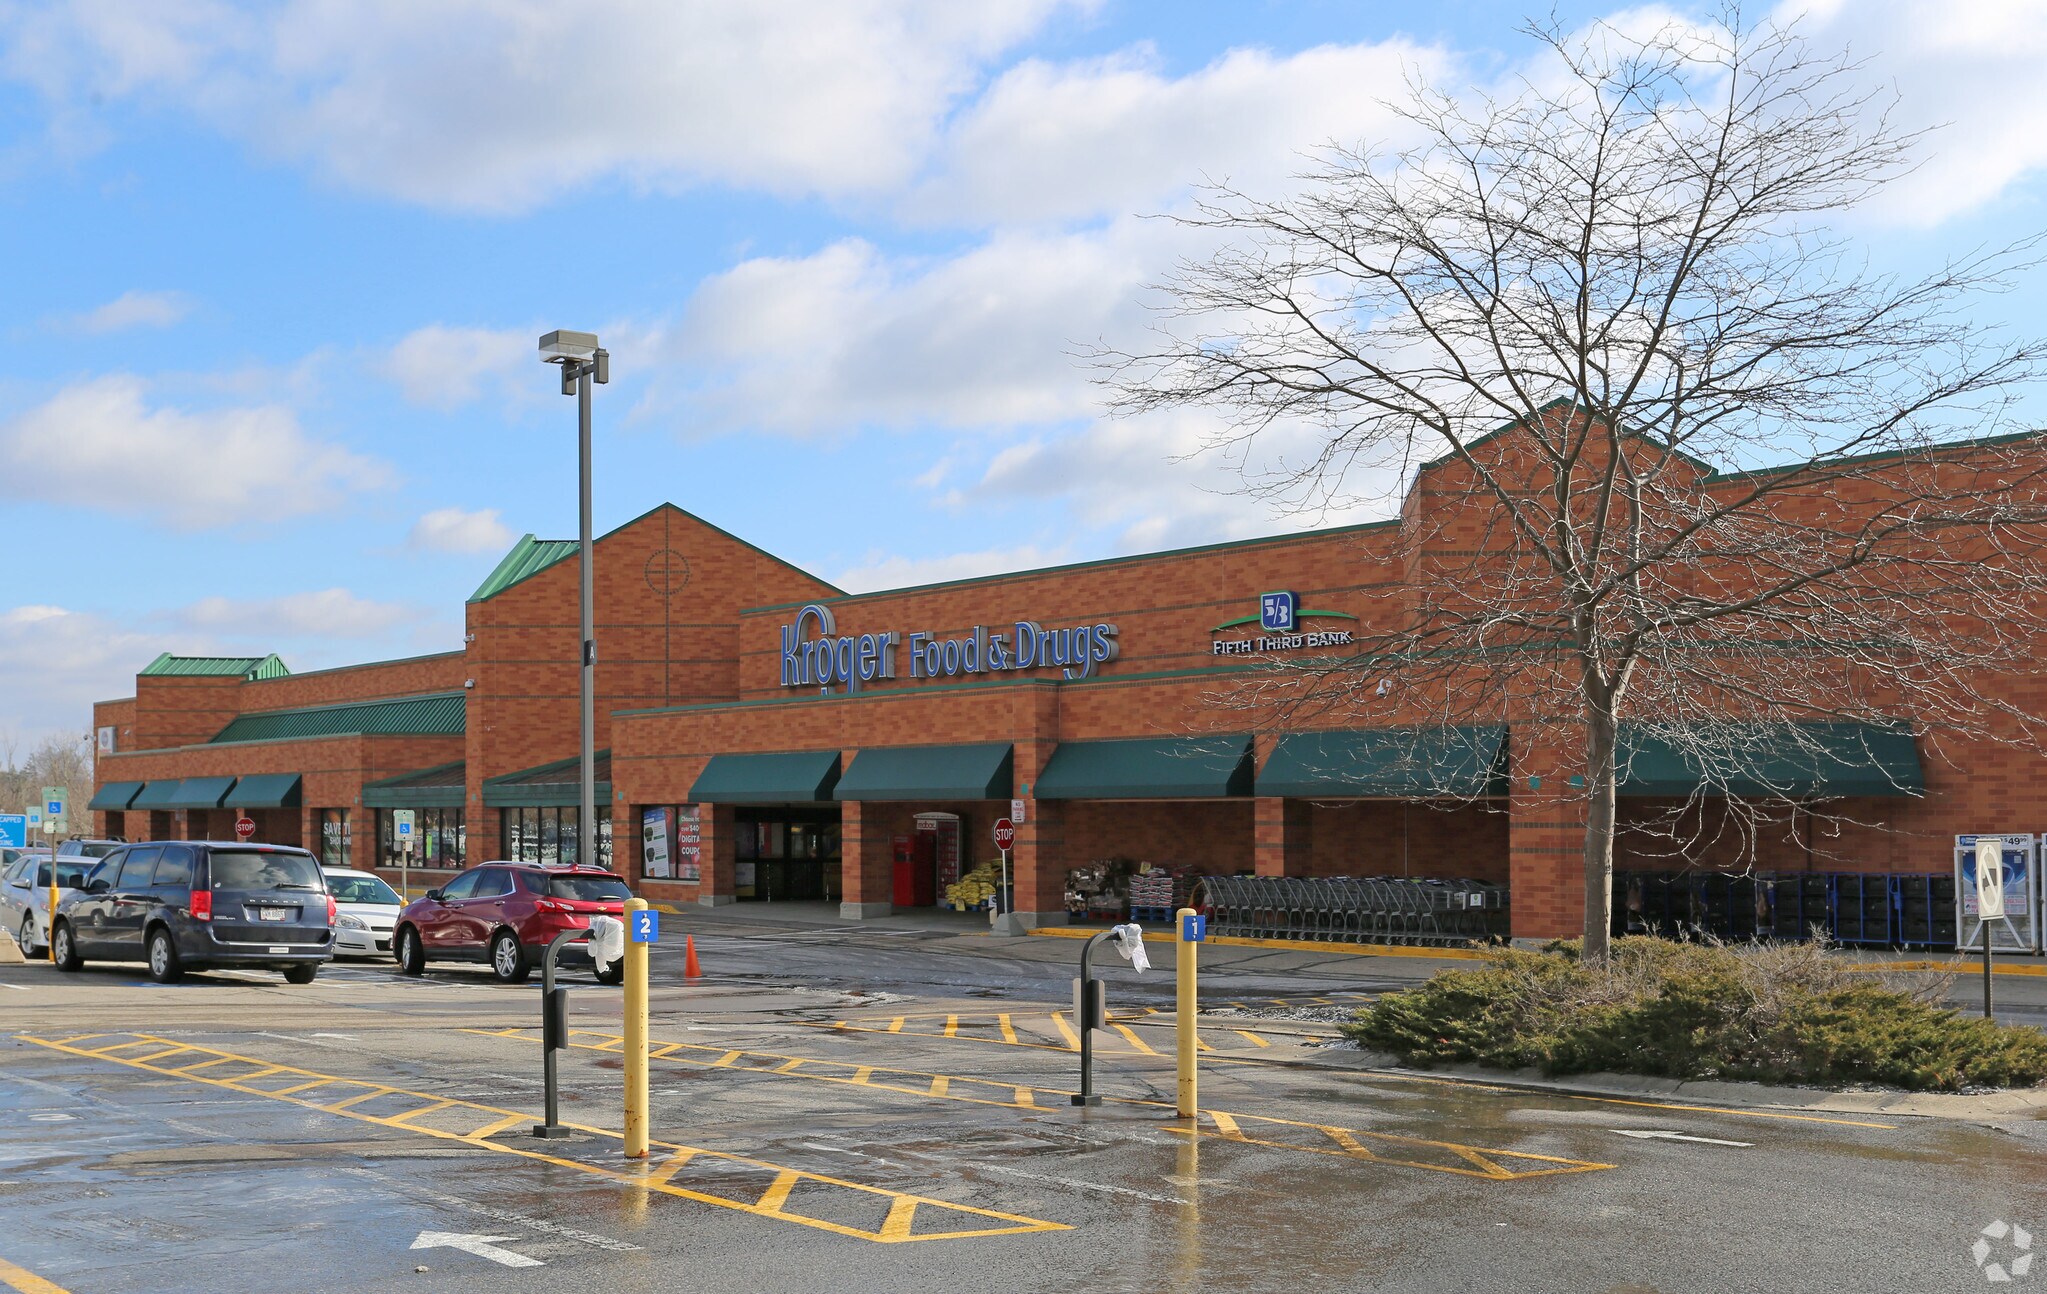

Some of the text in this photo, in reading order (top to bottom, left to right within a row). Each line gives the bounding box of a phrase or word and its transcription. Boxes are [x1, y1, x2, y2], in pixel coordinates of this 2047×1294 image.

[781, 604, 1116, 695] Kroger Food & Drugs
[323, 822, 341, 835] SAVE
[996, 828, 1013, 840] STOP
[640, 917, 651, 934] 2
[1191, 922, 1198, 935] 1
